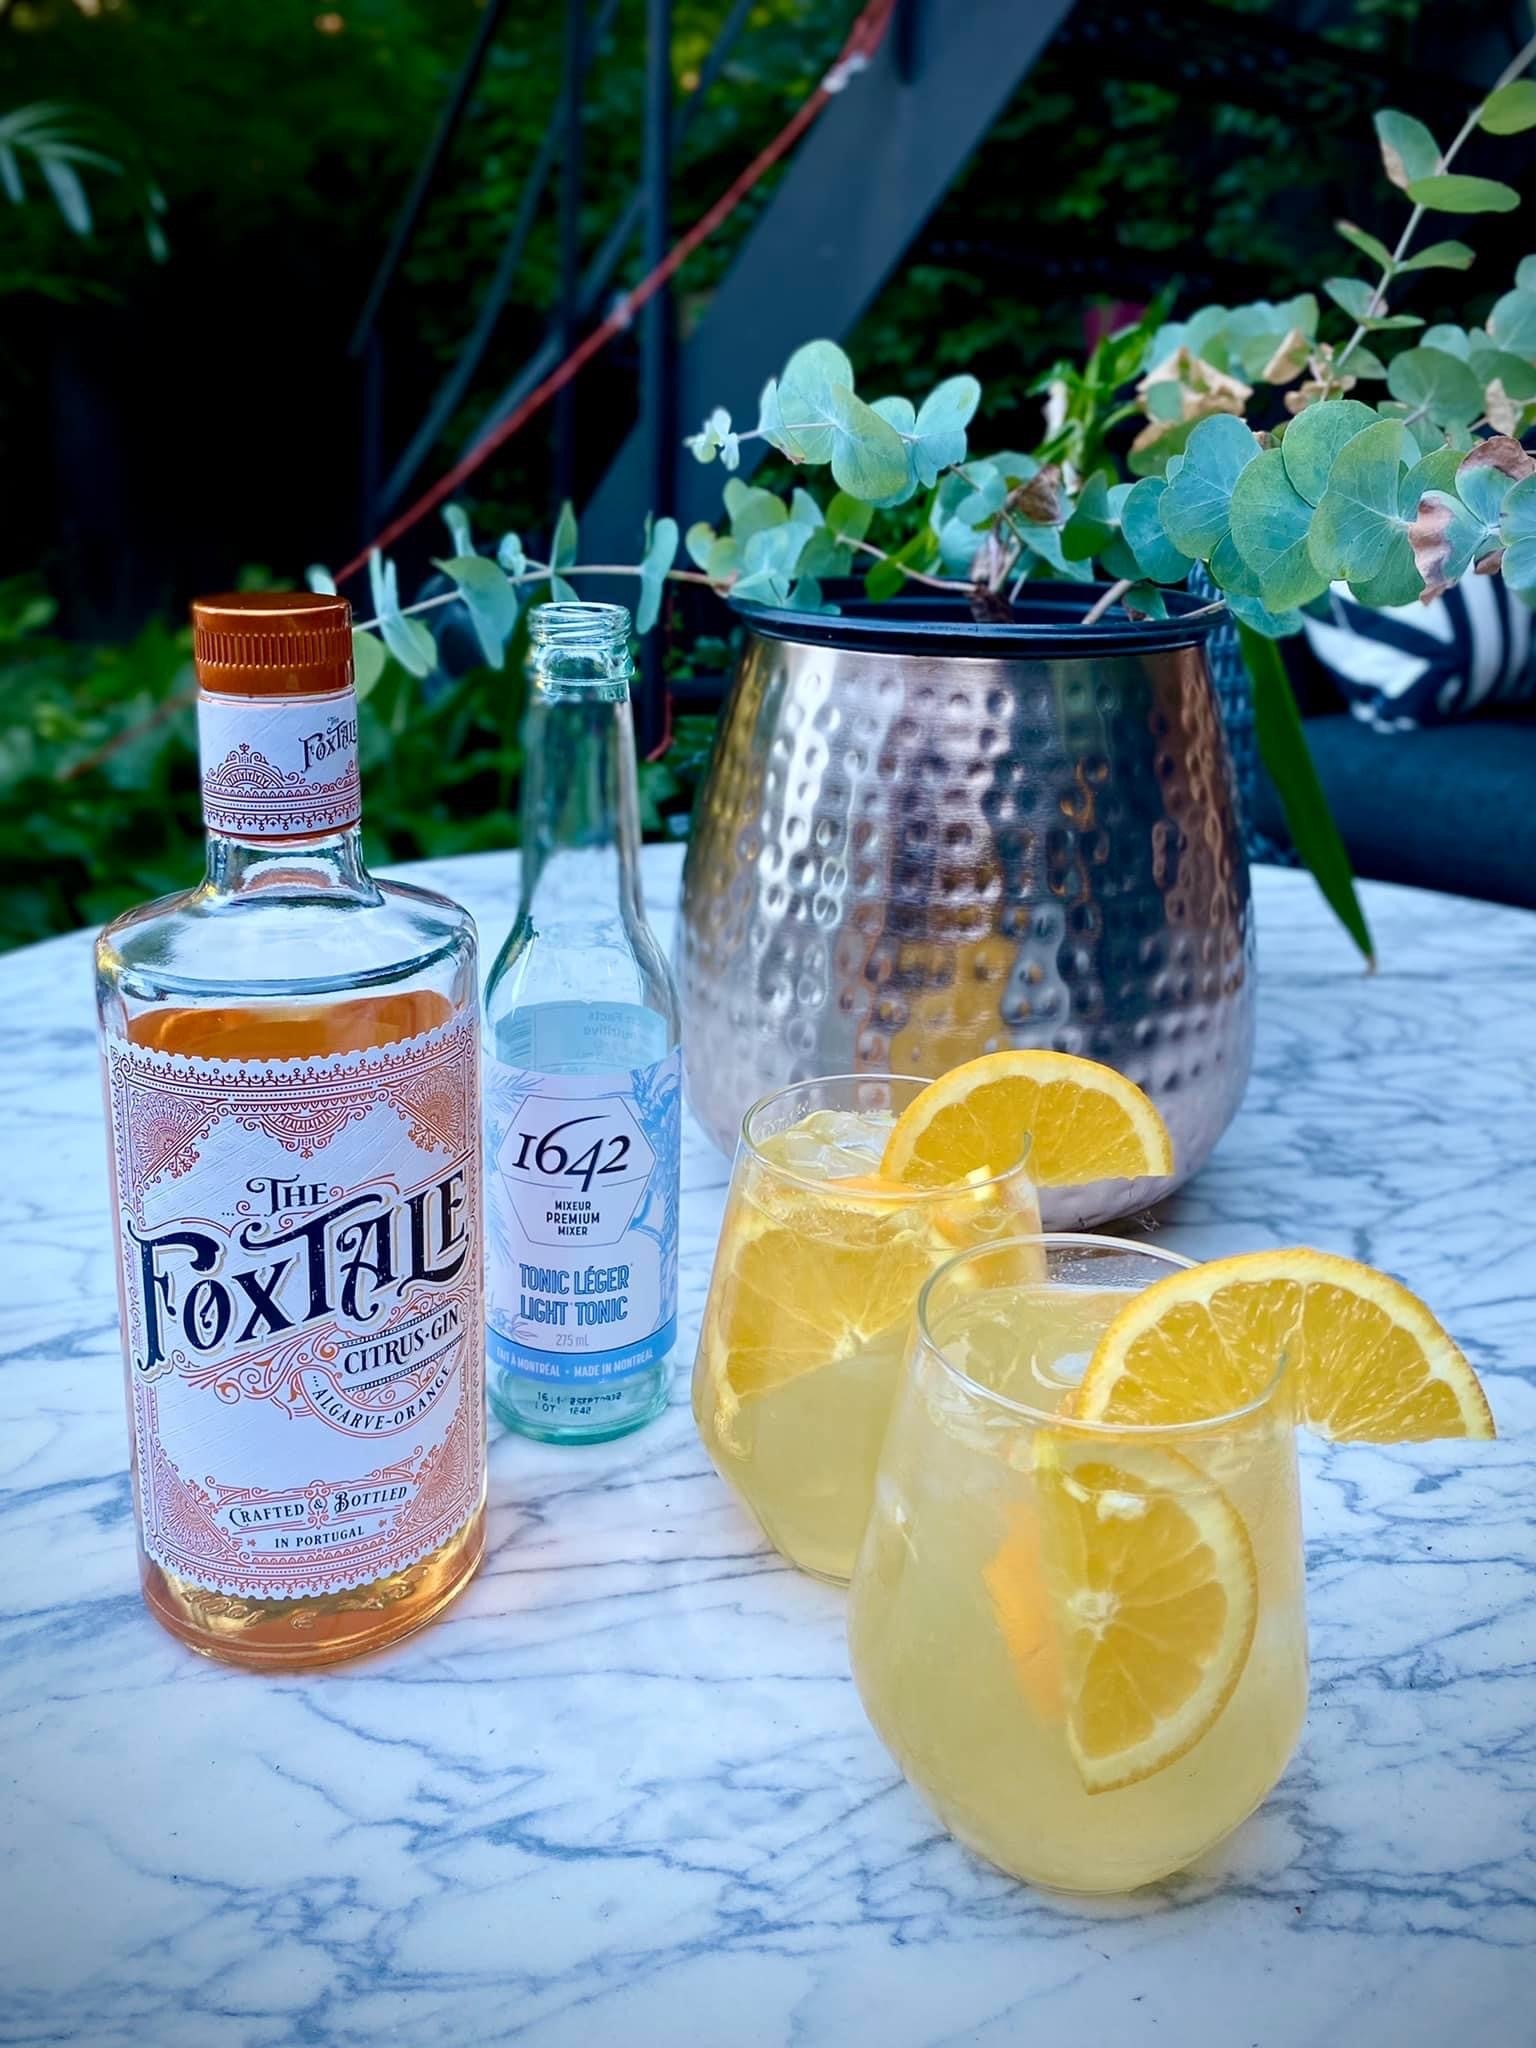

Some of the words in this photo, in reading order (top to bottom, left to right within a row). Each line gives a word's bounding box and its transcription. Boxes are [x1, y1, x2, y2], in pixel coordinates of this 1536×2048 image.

[512, 1114, 631, 1192] 1642
[246, 1174, 330, 1216] THE
[555, 1200, 591, 1211] MIXEUR
[546, 1212, 600, 1224] PREMIUM
[558, 1226, 588, 1236] MIXER
[519, 1263, 570, 1295] TONIC
[574, 1264, 630, 1295] LÉGER
[520, 1295, 568, 1326] LIGHT
[575, 1296, 629, 1326] TONIC
[556, 1334, 573, 1346] 275
[576, 1335, 589, 1346] mL
[574, 1365, 600, 1377] MADE
[602, 1362, 612, 1375] IN
[229, 1503, 304, 1527] CRAFTED
[313, 1499, 324, 1510] &
[334, 1486, 407, 1514] BOTTLED
[275, 1537, 289, 1548] IN
[296, 1525, 365, 1547] PORTUGAL
